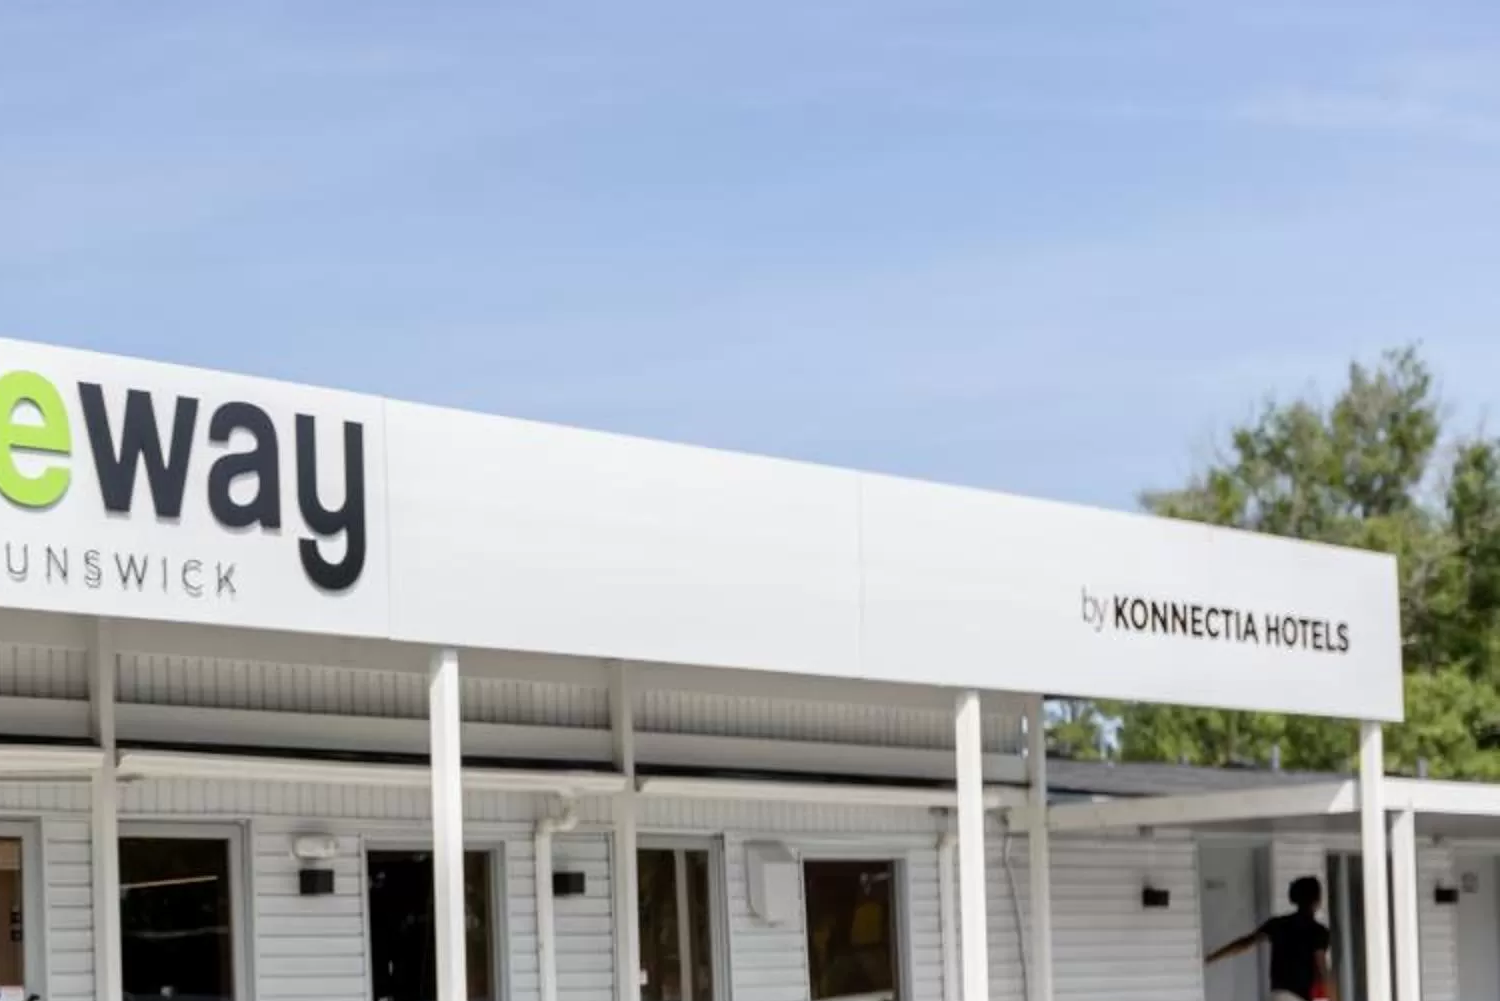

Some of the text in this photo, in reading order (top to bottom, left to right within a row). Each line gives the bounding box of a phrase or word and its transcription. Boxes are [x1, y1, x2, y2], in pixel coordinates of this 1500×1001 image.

[1080, 584, 1350, 653] by KONNECTIA HOTELS
